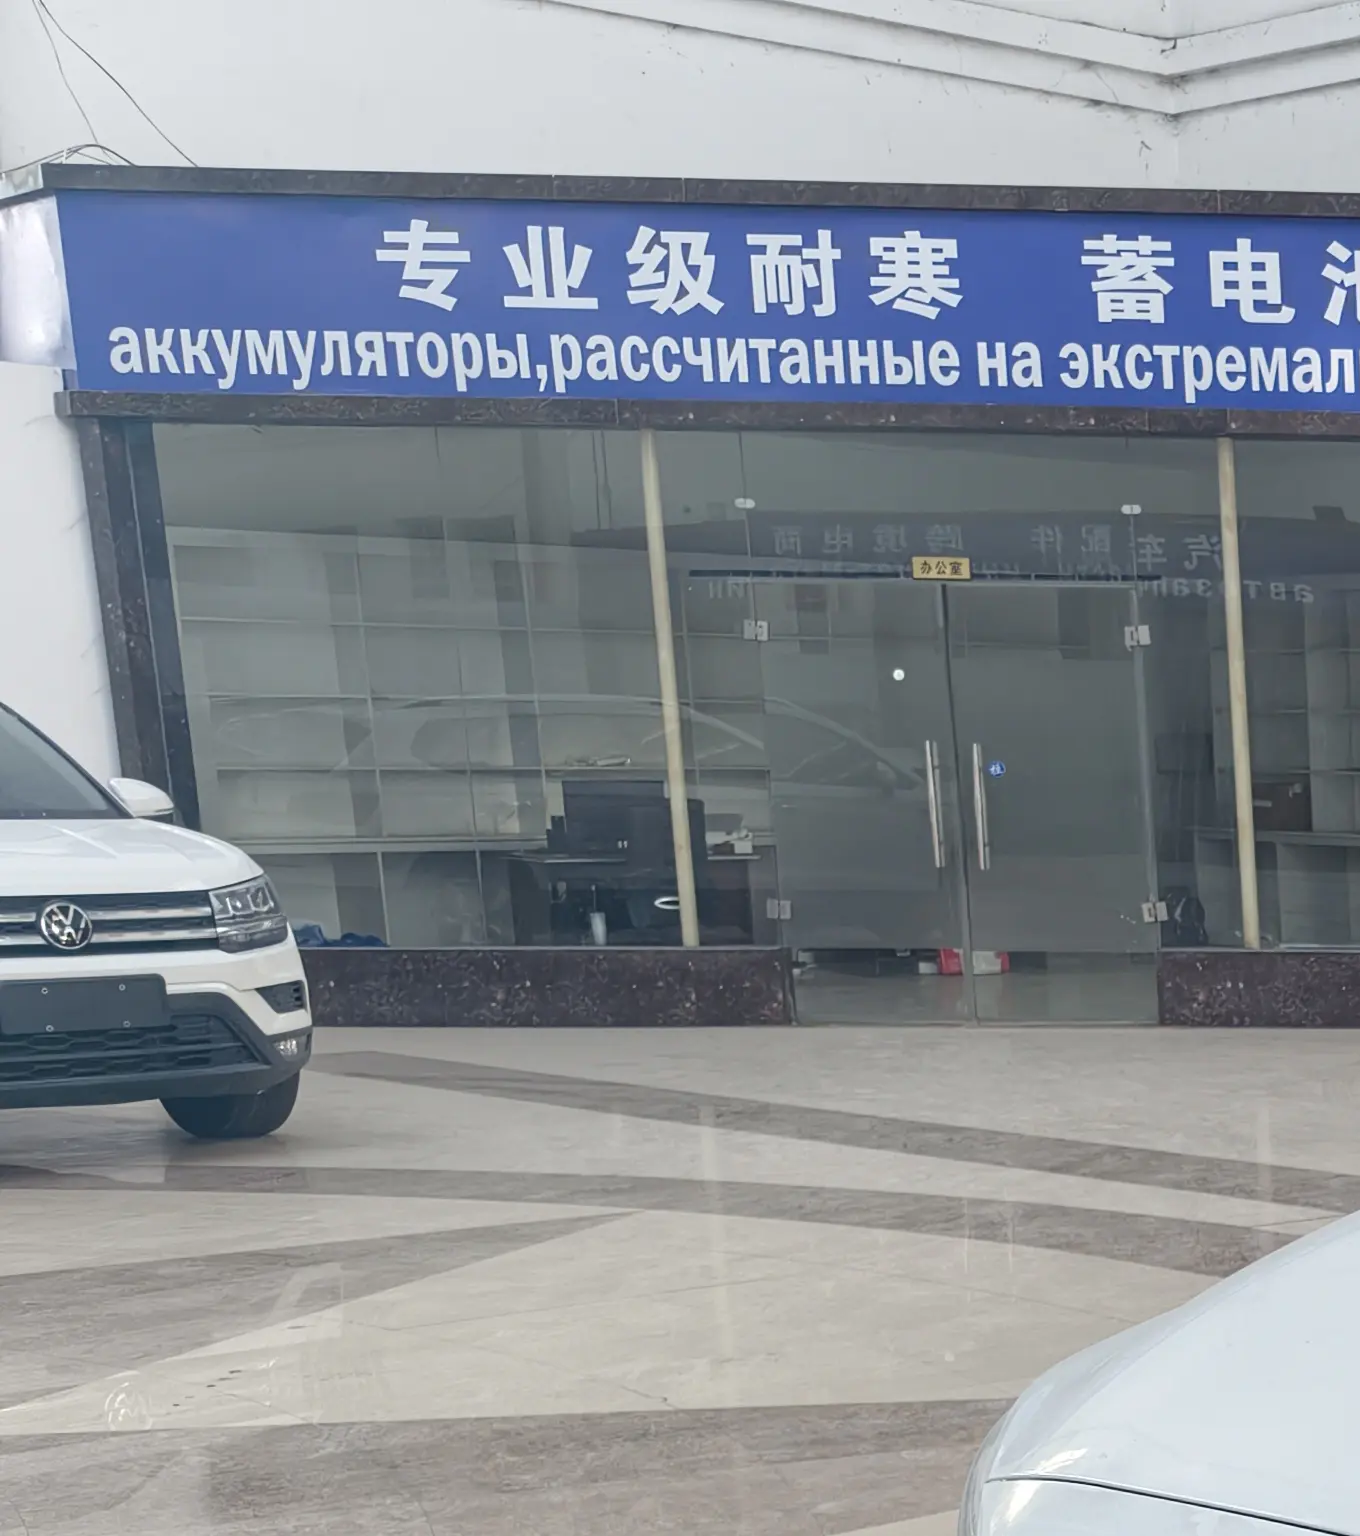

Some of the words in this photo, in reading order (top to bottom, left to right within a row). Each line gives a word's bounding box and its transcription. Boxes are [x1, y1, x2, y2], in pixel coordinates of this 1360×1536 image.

[376, 219, 963, 320] 专业级耐寒
[110, 326, 960, 393] аккумуляторы,рассчитанные
[977, 341, 1043, 388] на
[920, 559, 964, 576] 办公室
